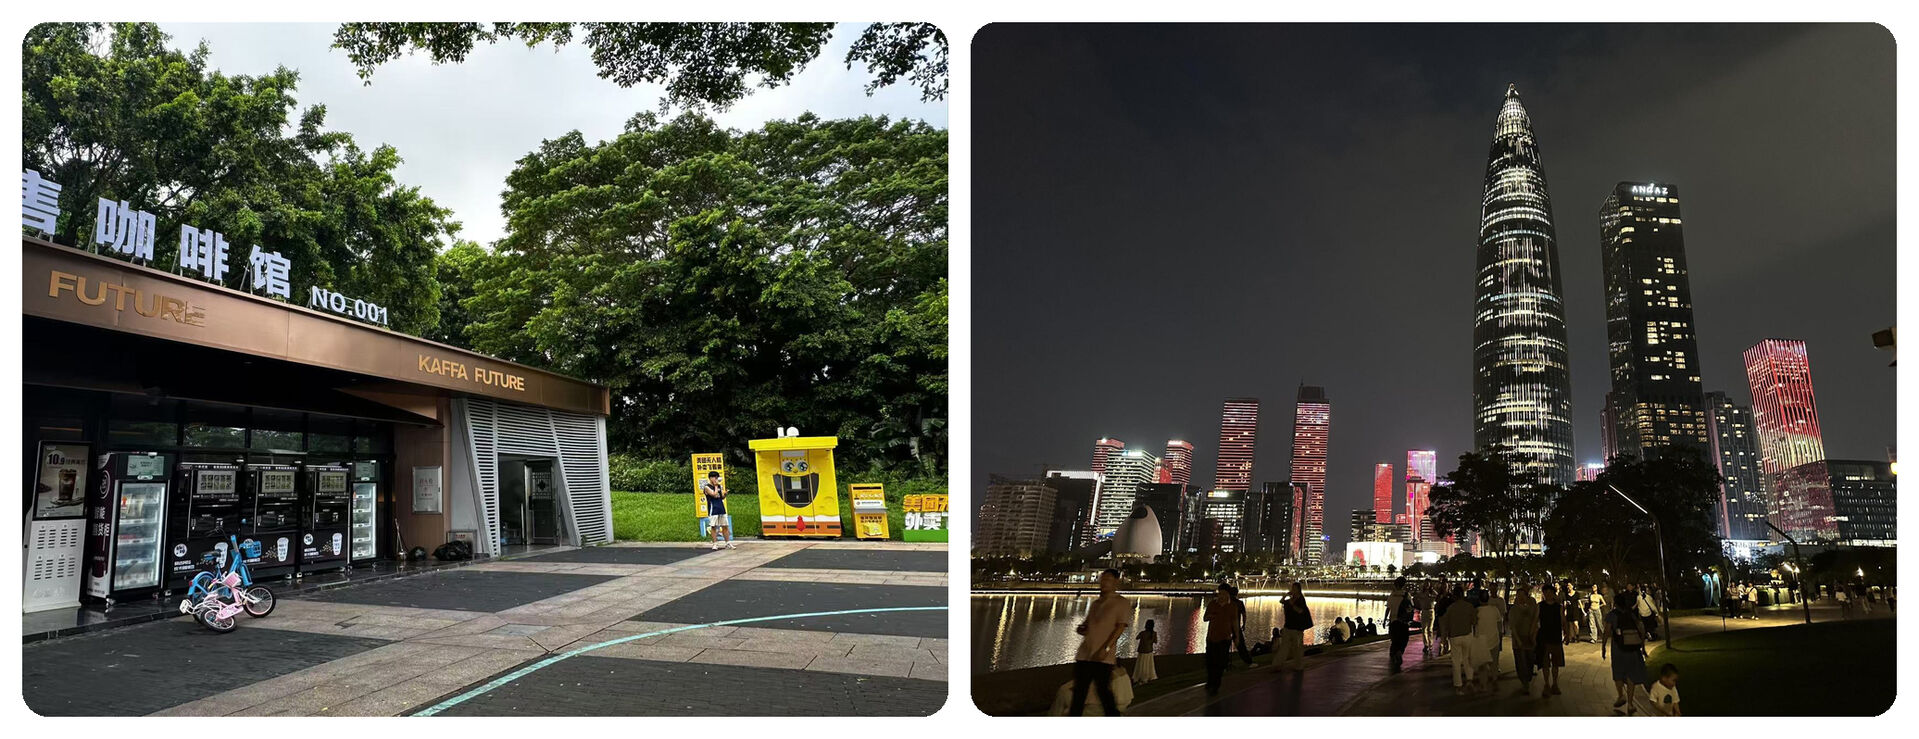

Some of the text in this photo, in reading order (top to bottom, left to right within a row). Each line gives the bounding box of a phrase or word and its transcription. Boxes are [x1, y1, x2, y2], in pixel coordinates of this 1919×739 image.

[312, 285, 388, 325] NO.001
[418, 354, 525, 392] KAFFA FUTURE
